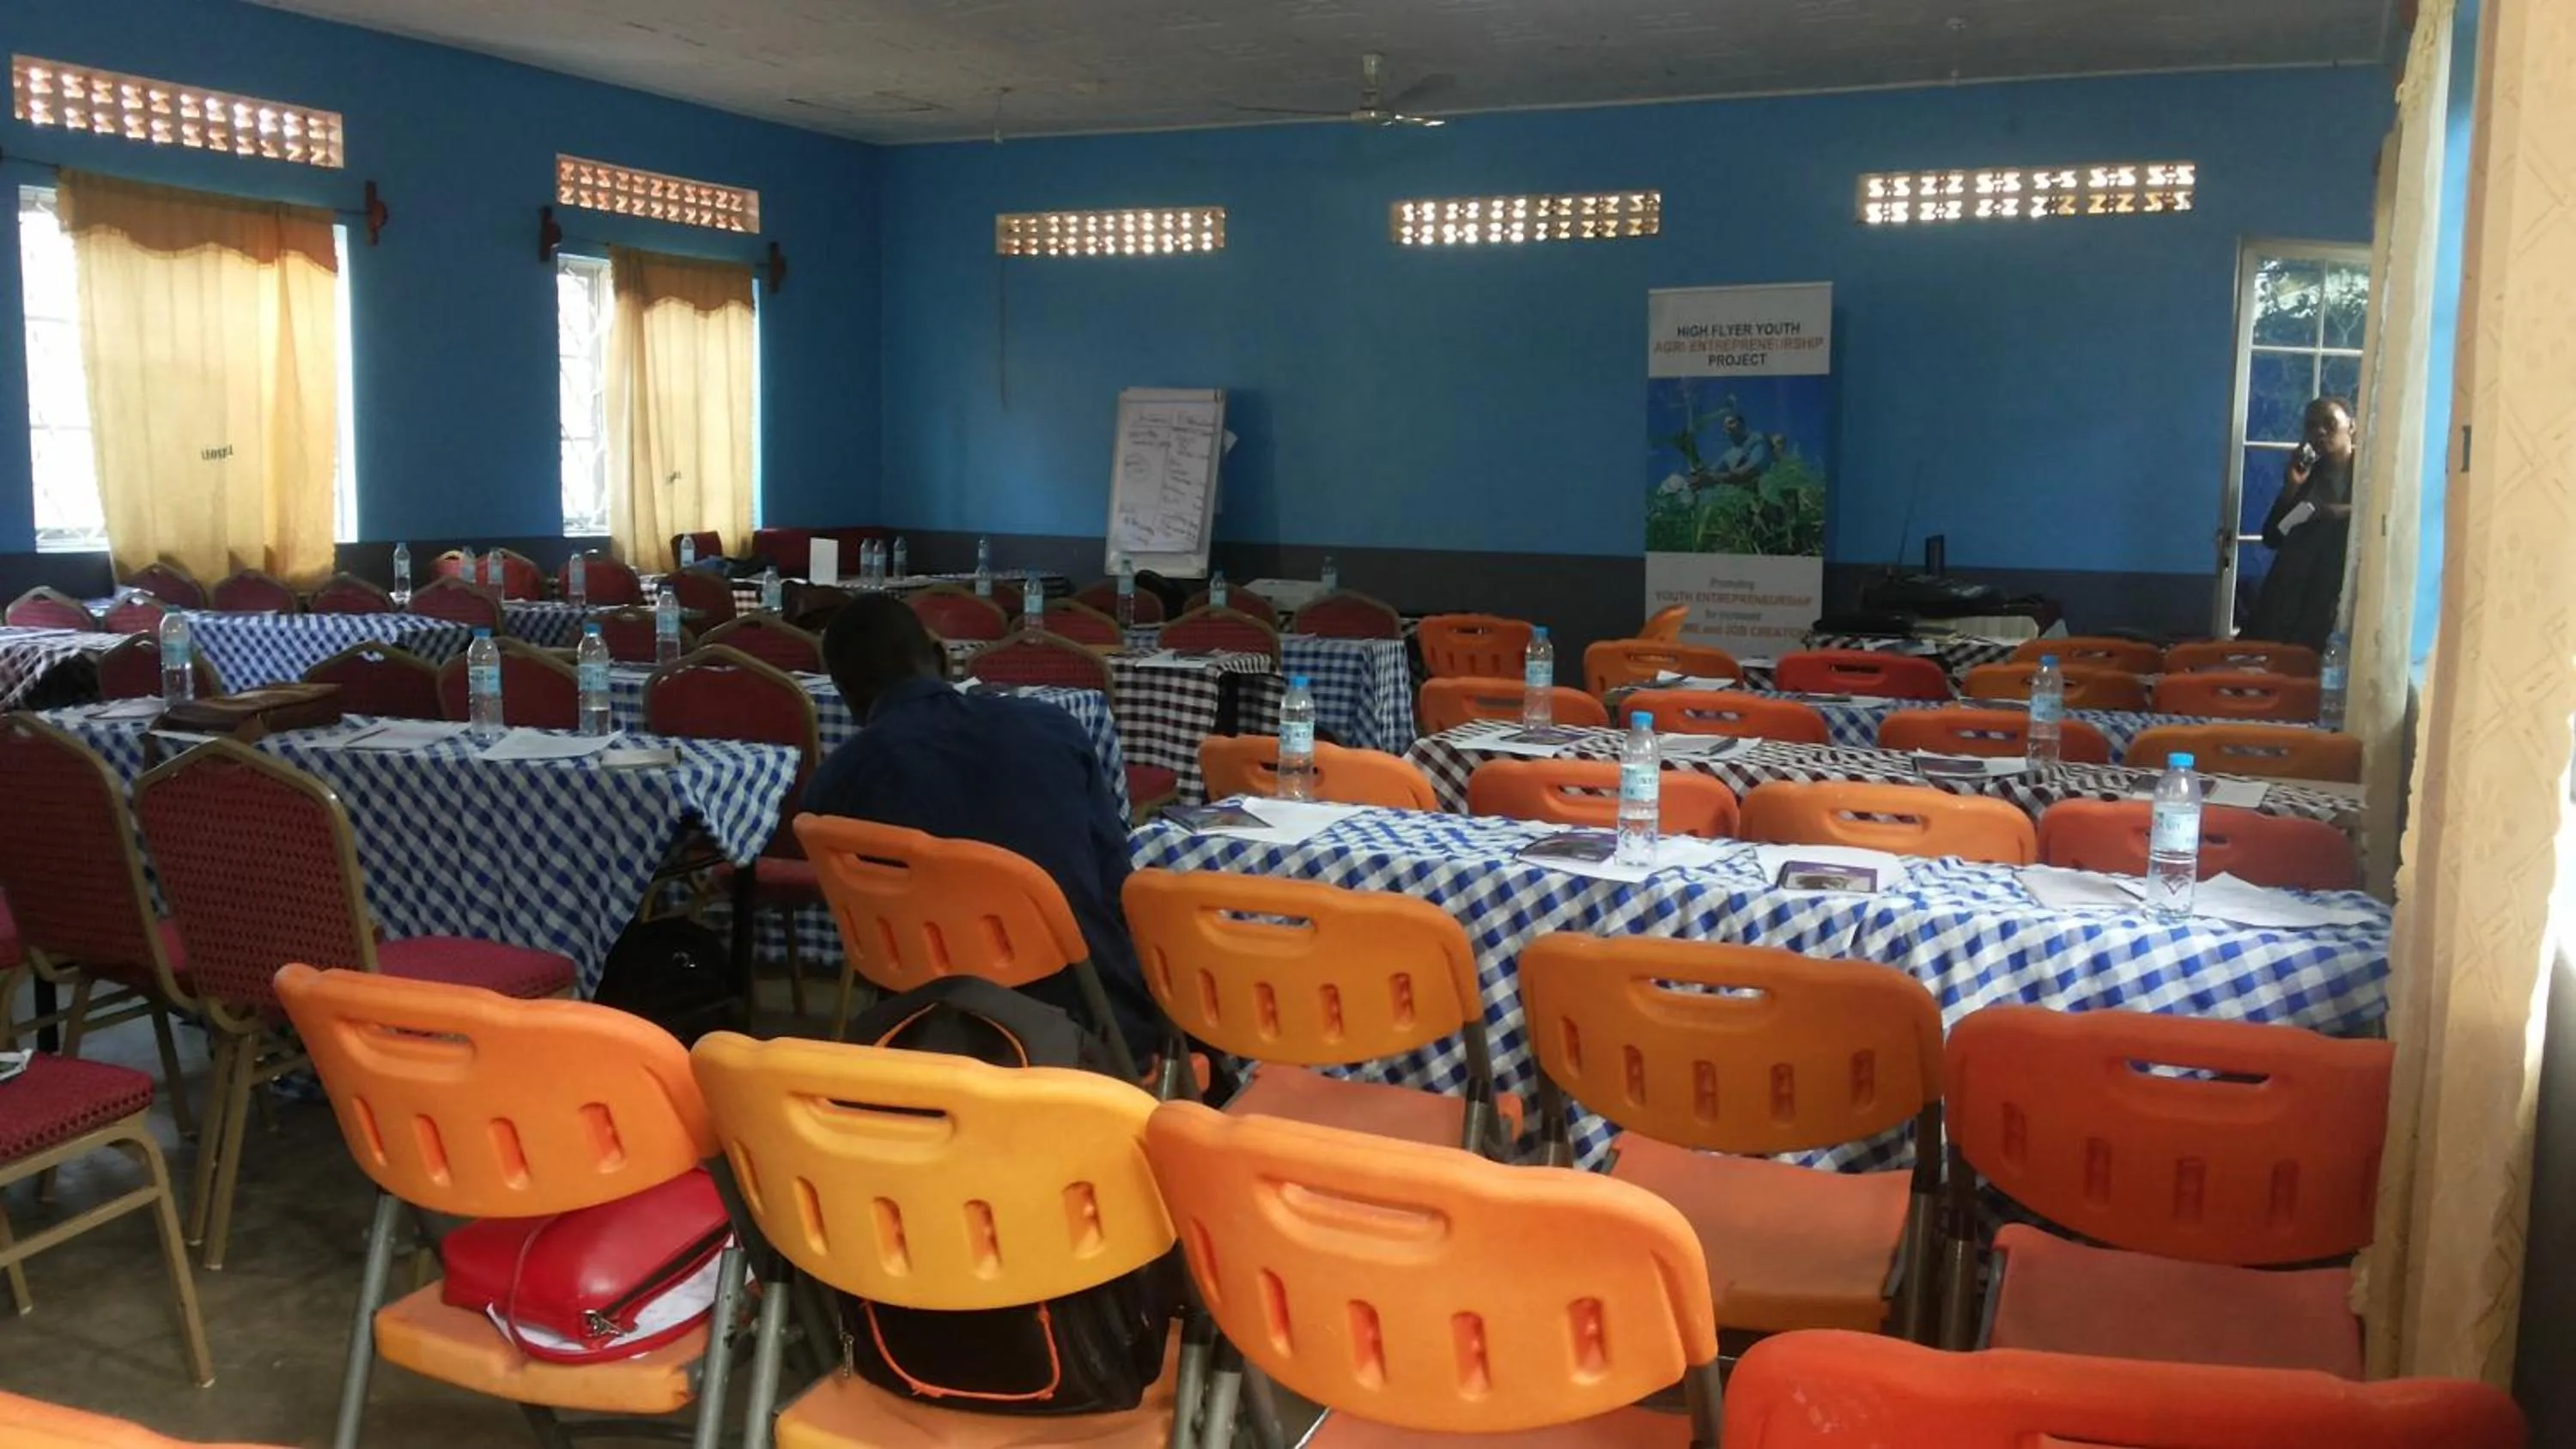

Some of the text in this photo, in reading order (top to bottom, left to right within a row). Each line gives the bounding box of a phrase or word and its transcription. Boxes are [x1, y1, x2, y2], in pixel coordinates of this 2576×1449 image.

[1677, 321, 1801, 337] HIGH FLYER YOUTH
[1708, 353, 1767, 367] PROJECT
[1656, 591, 1692, 602] YOUTH
[1726, 625, 1747, 637] JOB
